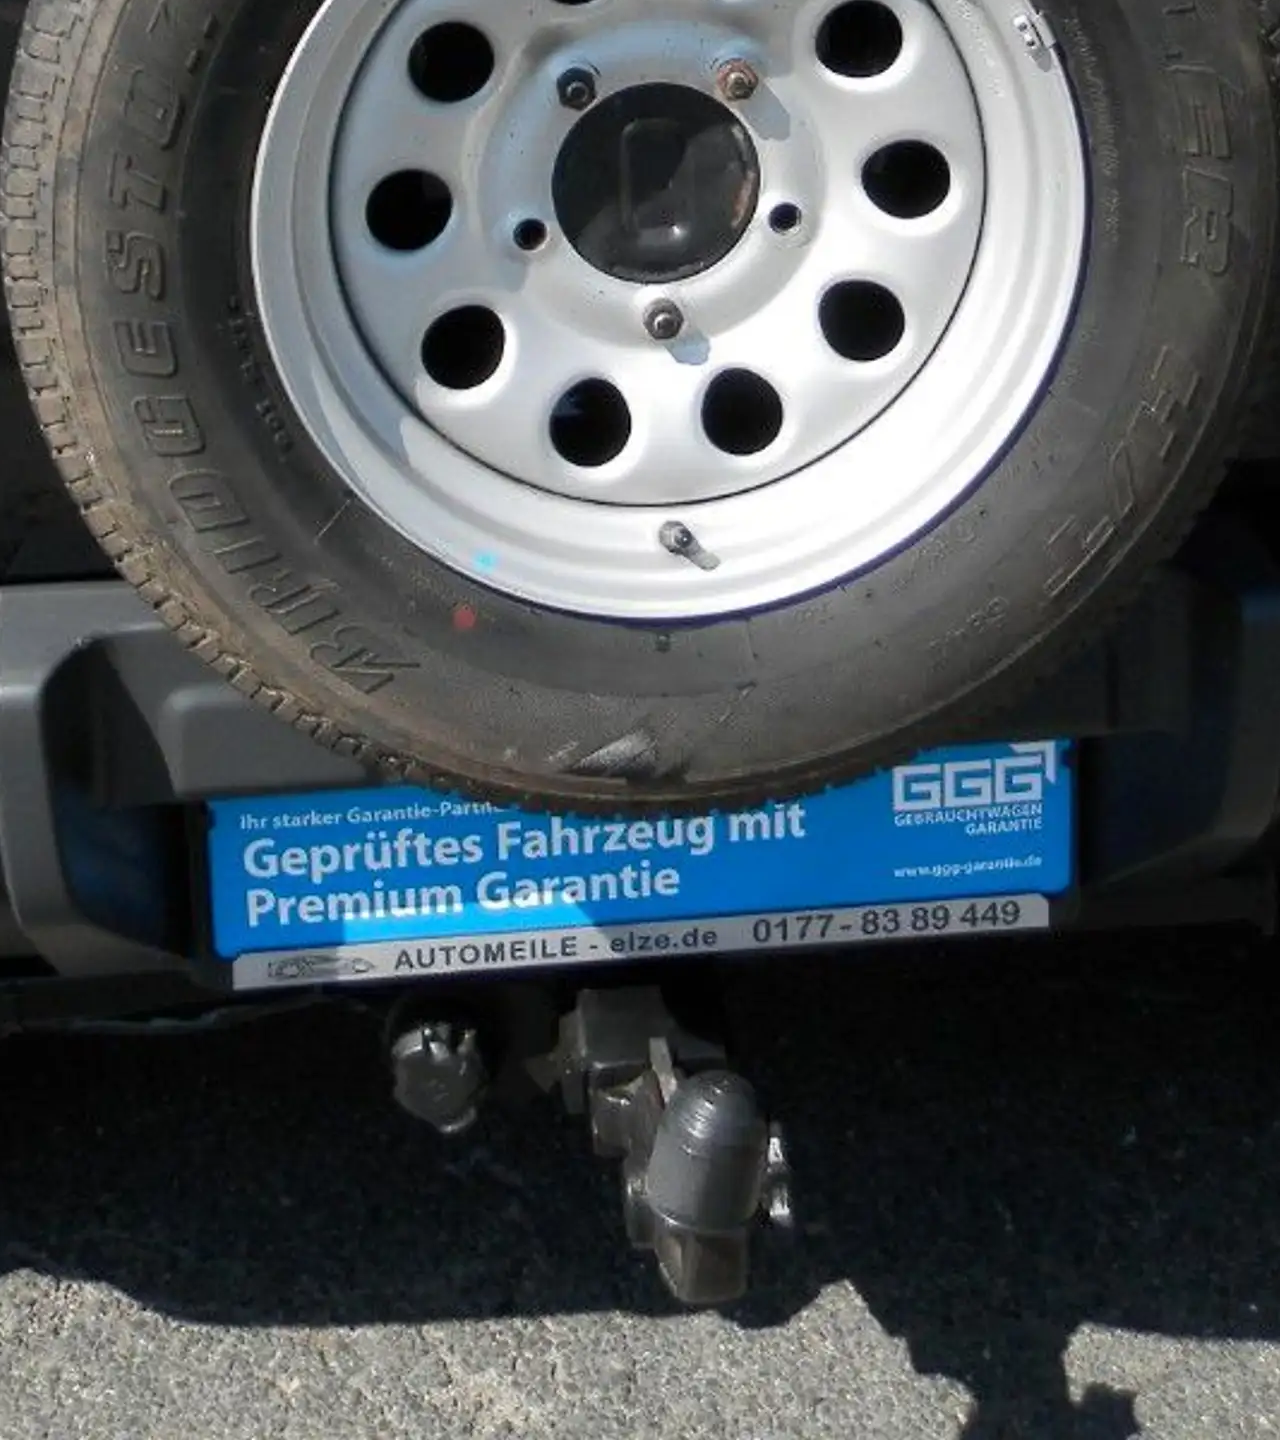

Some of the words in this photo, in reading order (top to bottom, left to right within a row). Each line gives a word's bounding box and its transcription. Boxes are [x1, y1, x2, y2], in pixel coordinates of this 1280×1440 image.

[892, 752, 1044, 811] GGG
[240, 813, 268, 830] Ihr
[272, 809, 342, 830] starker
[346, 800, 505, 825] Garantie-Partn
[243, 827, 484, 885] Geprüftes
[497, 815, 715, 861] Fahrzeug
[729, 803, 807, 842] mit
[894, 803, 1043, 828] GEBRAUCHTWAGEN
[965, 817, 1043, 837] GARANTIE
[246, 879, 464, 928] Premium
[476, 859, 681, 910] Garantie
[394, 935, 578, 971] AUTOMEILE
[610, 928, 718, 954] elze.de
[752, 913, 834, 943] 0177
[860, 909, 901, 936] 83
[910, 904, 950, 932] 89
[959, 899, 1021, 927] 449
